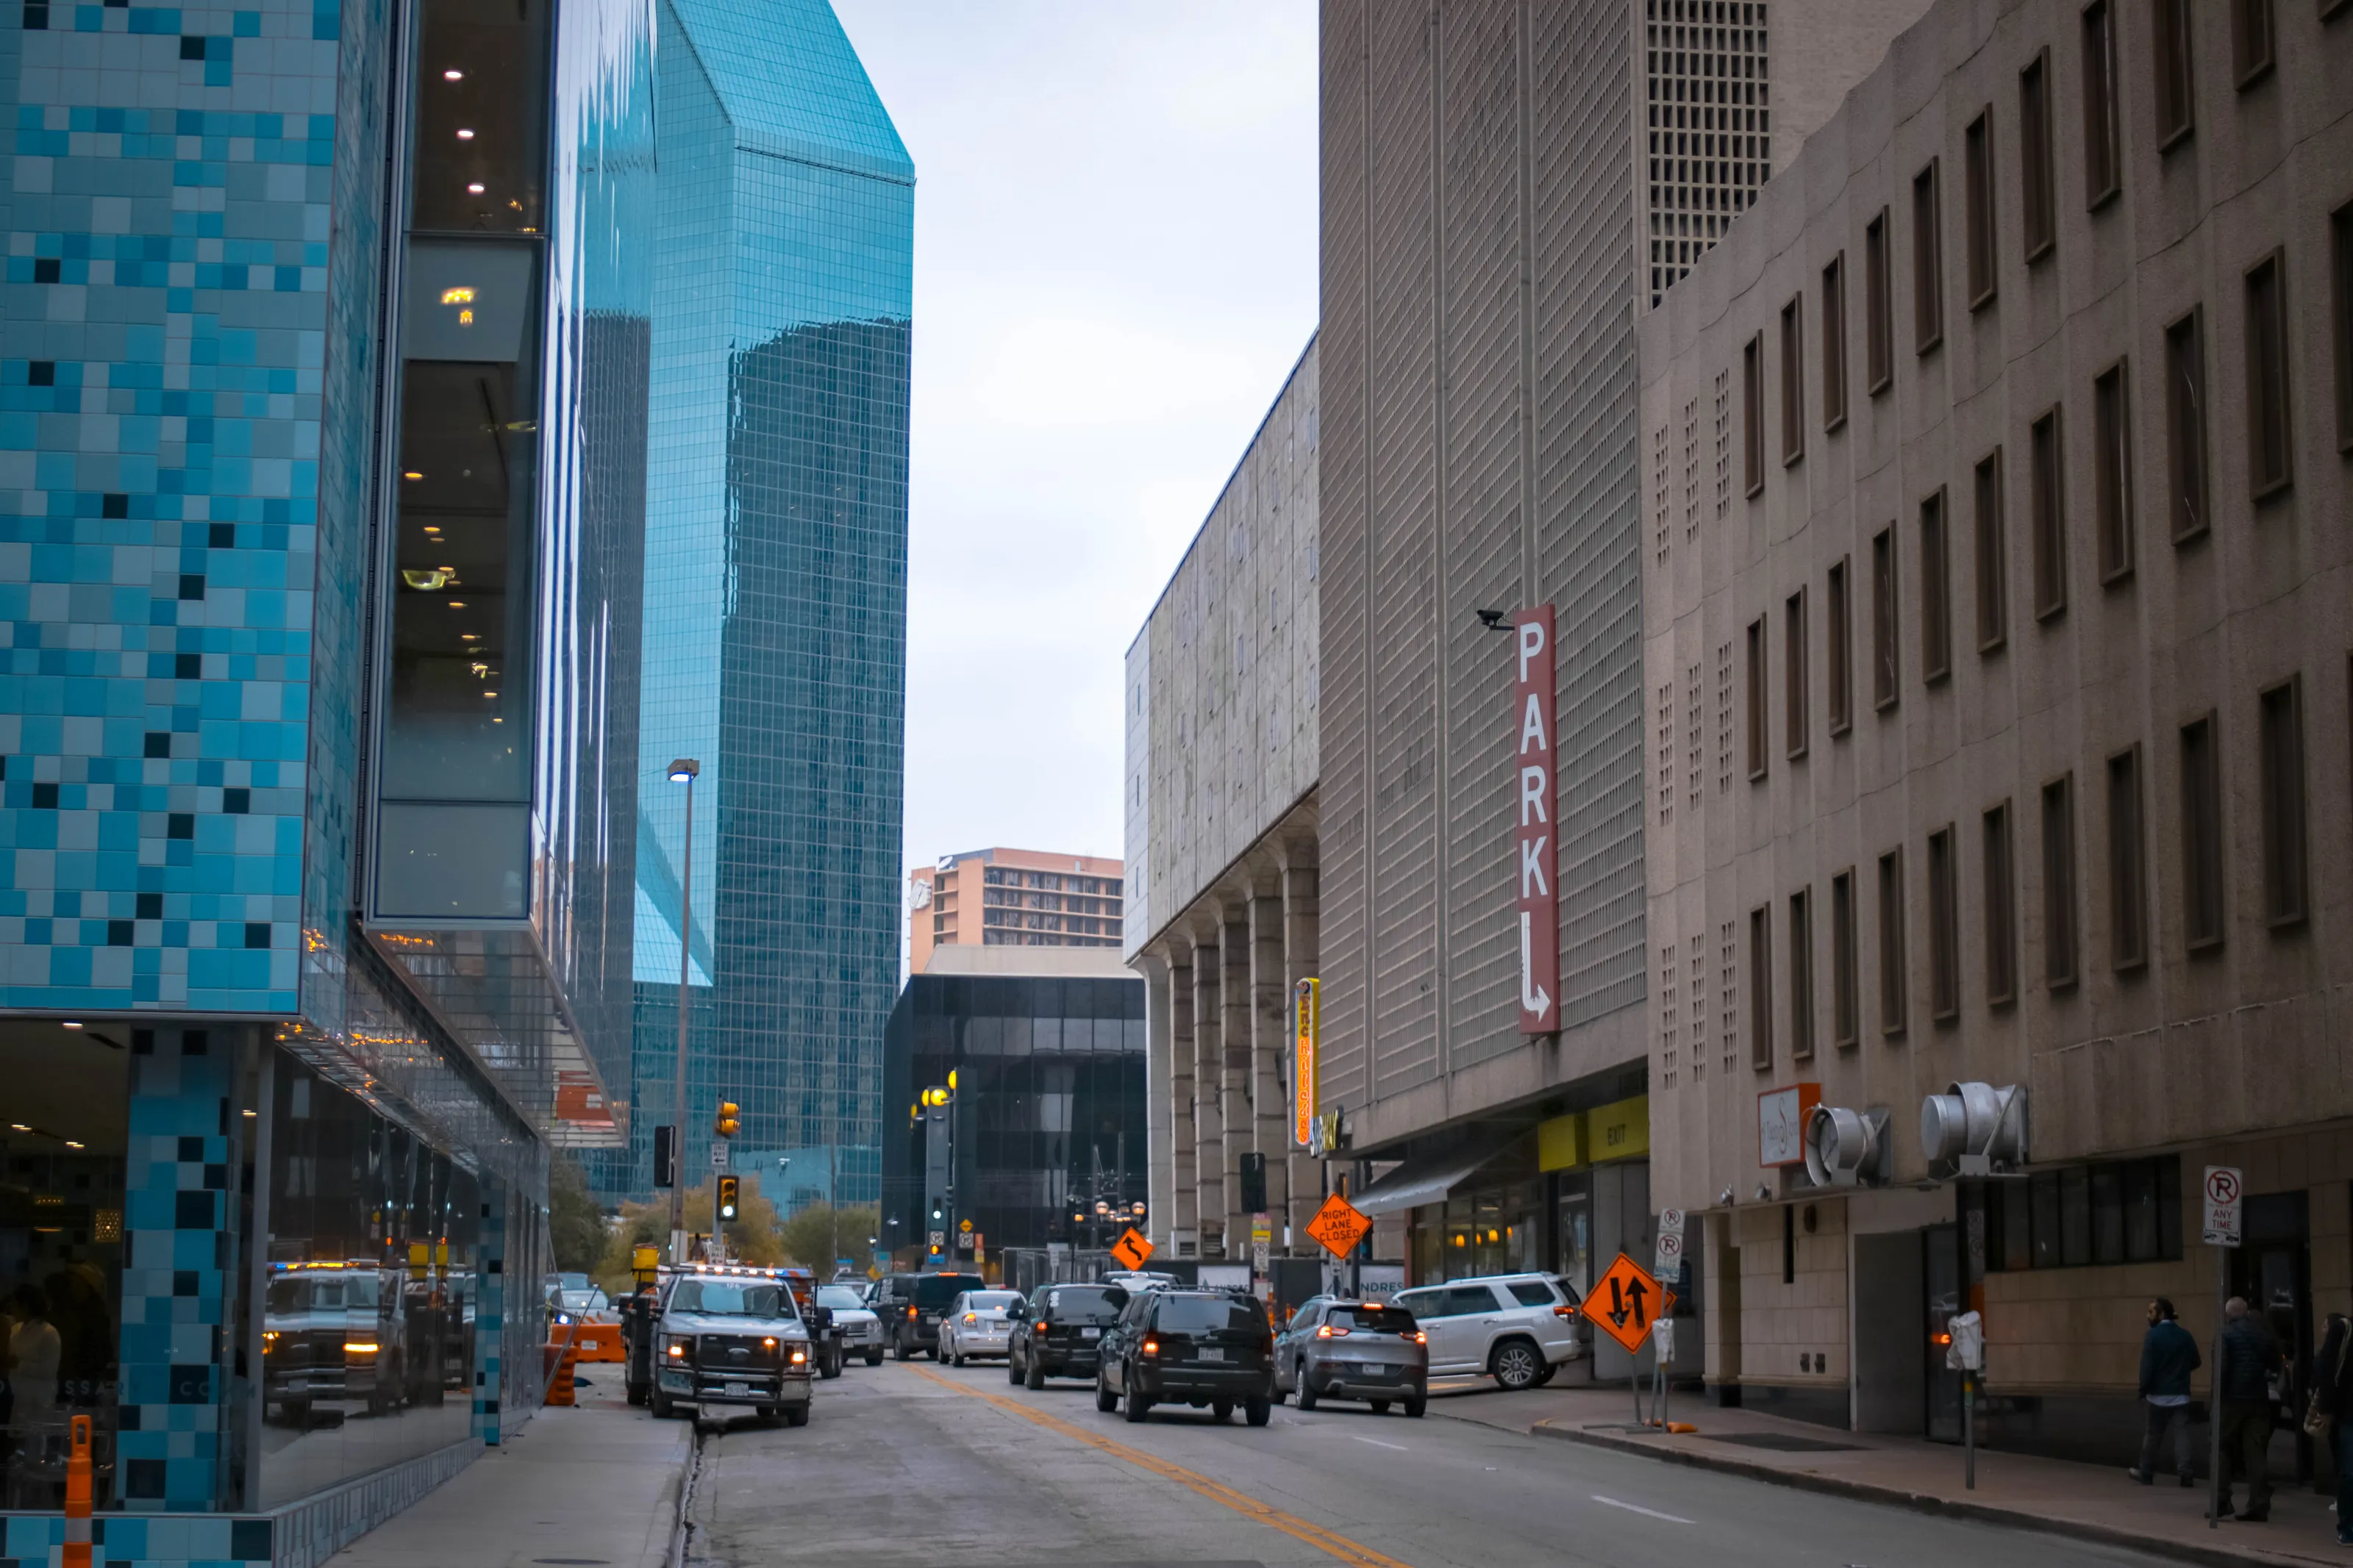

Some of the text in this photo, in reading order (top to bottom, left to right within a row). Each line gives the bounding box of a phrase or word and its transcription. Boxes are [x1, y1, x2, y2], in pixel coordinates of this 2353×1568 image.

[1519, 621, 1548, 899] PARK
[1299, 995, 1310, 1143] Enchiladas
[1310, 1109, 1338, 1157] SUBWAY
[1607, 1123, 1627, 1147] EXIT
[1322, 1208, 1352, 1220] RIGHT
[2213, 1209, 2232, 1220] ANY
[1324, 1219, 1352, 1231] LANE
[2213, 1219, 2232, 1230] TIME
[1319, 1228, 1360, 1242] CLOSED
[1360, 1281, 1404, 1292] NDRES
[792, 1381, 804, 1392] 126
